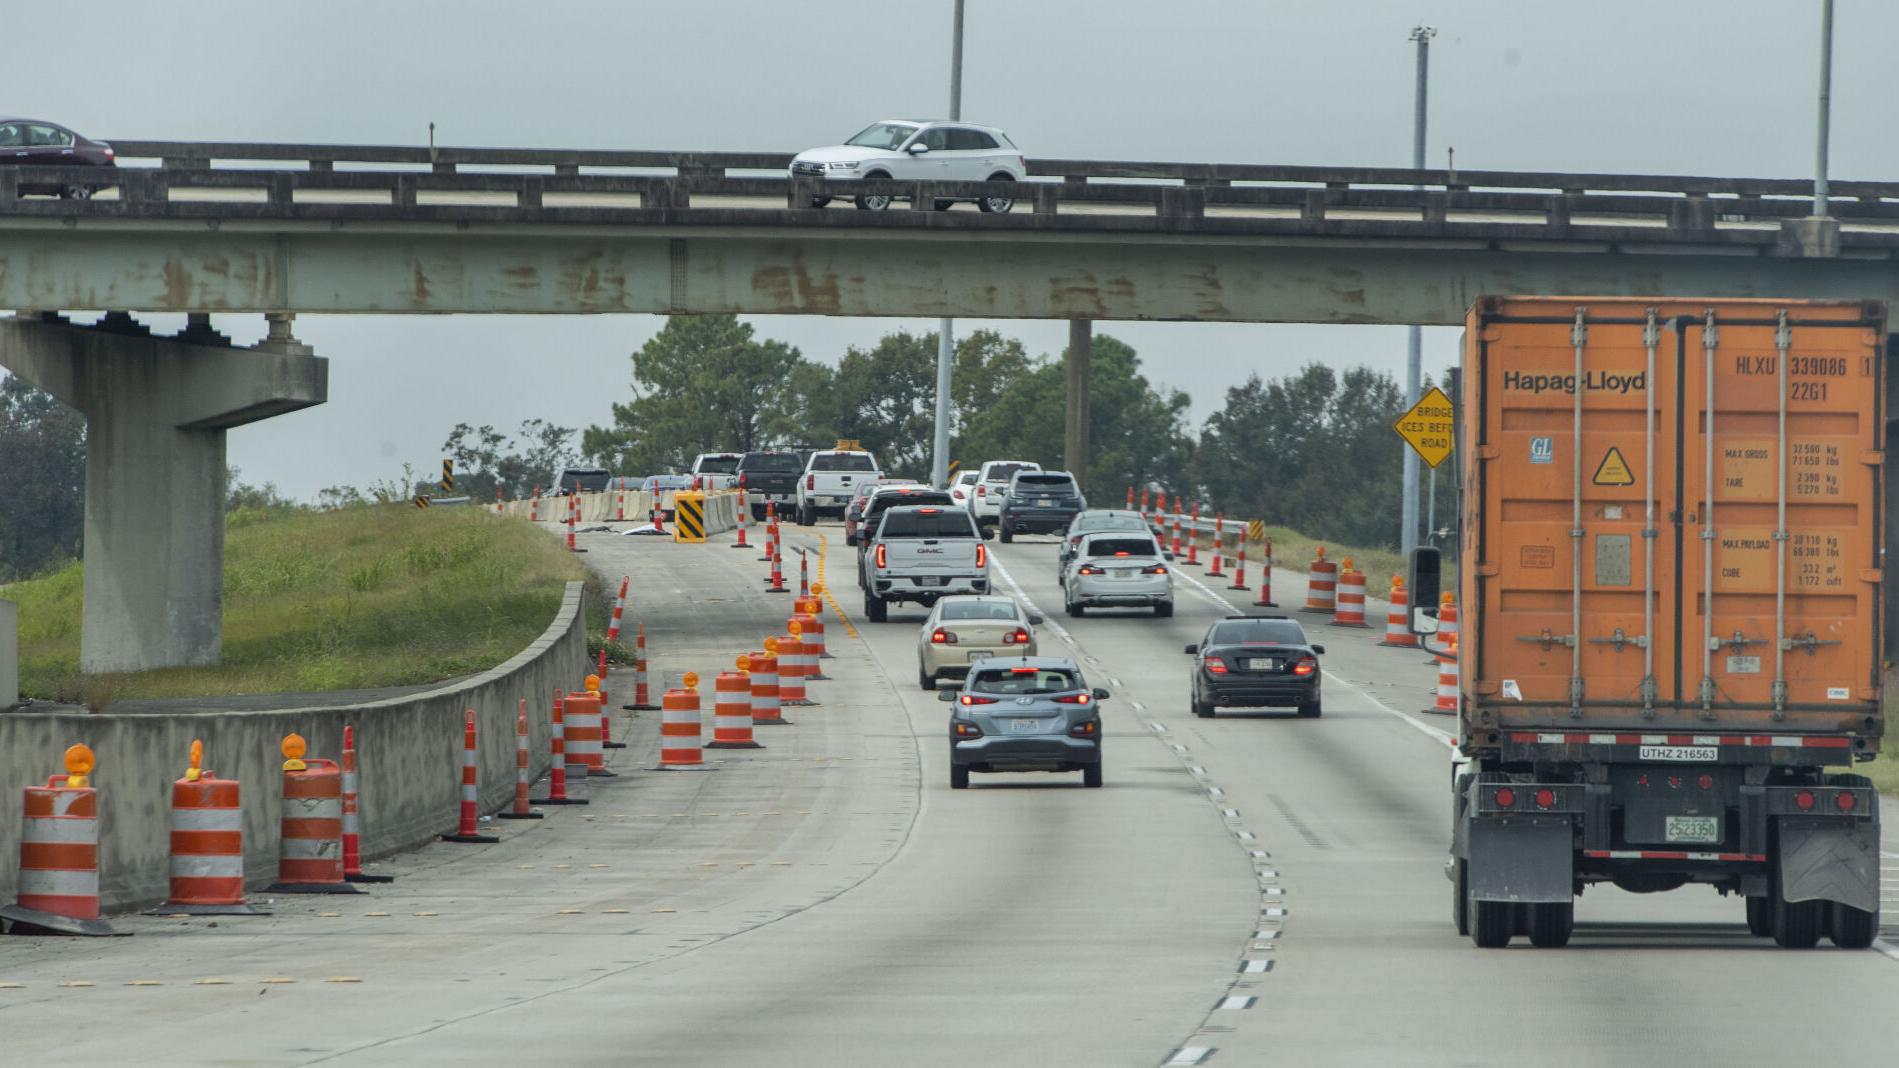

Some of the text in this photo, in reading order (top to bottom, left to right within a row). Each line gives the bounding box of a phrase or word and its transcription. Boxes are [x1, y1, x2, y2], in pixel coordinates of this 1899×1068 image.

[1736, 356, 1776, 376] HLXU
[1791, 356, 1846, 376] 339086
[1504, 370, 1646, 394] Hapag-Lloyd
[1791, 382, 1827, 401] 22G1
[1417, 407, 1453, 417] BRIDGE
[1421, 438, 1448, 448] ROAD
[1725, 478, 1744, 488] TARE
[1721, 567, 1741, 578] CUBE
[1641, 748, 1716, 759] UTHZ 216563
